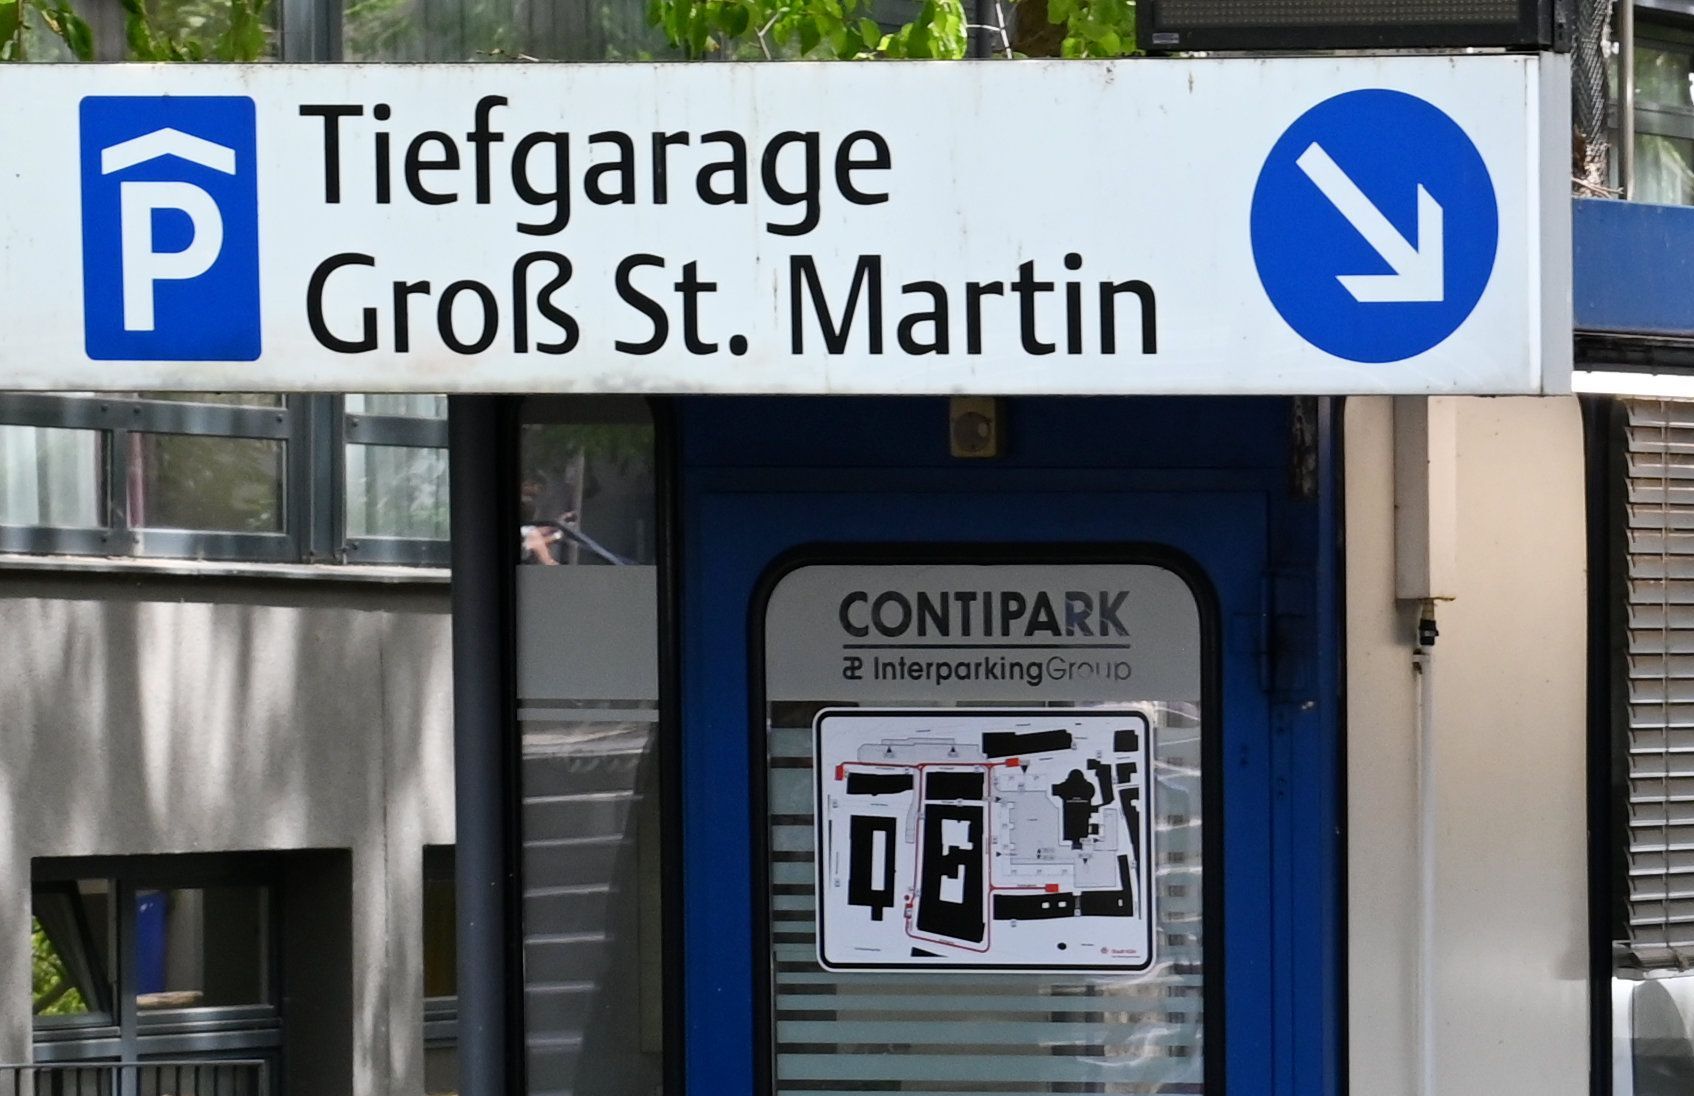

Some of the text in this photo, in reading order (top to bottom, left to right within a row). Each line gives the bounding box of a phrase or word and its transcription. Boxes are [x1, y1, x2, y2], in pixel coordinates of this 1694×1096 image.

[299, 95, 891, 236] Tiefgarage
[307, 251, 1157, 356] Groß St. Martin
[839, 591, 1130, 637] CONTIPARK
